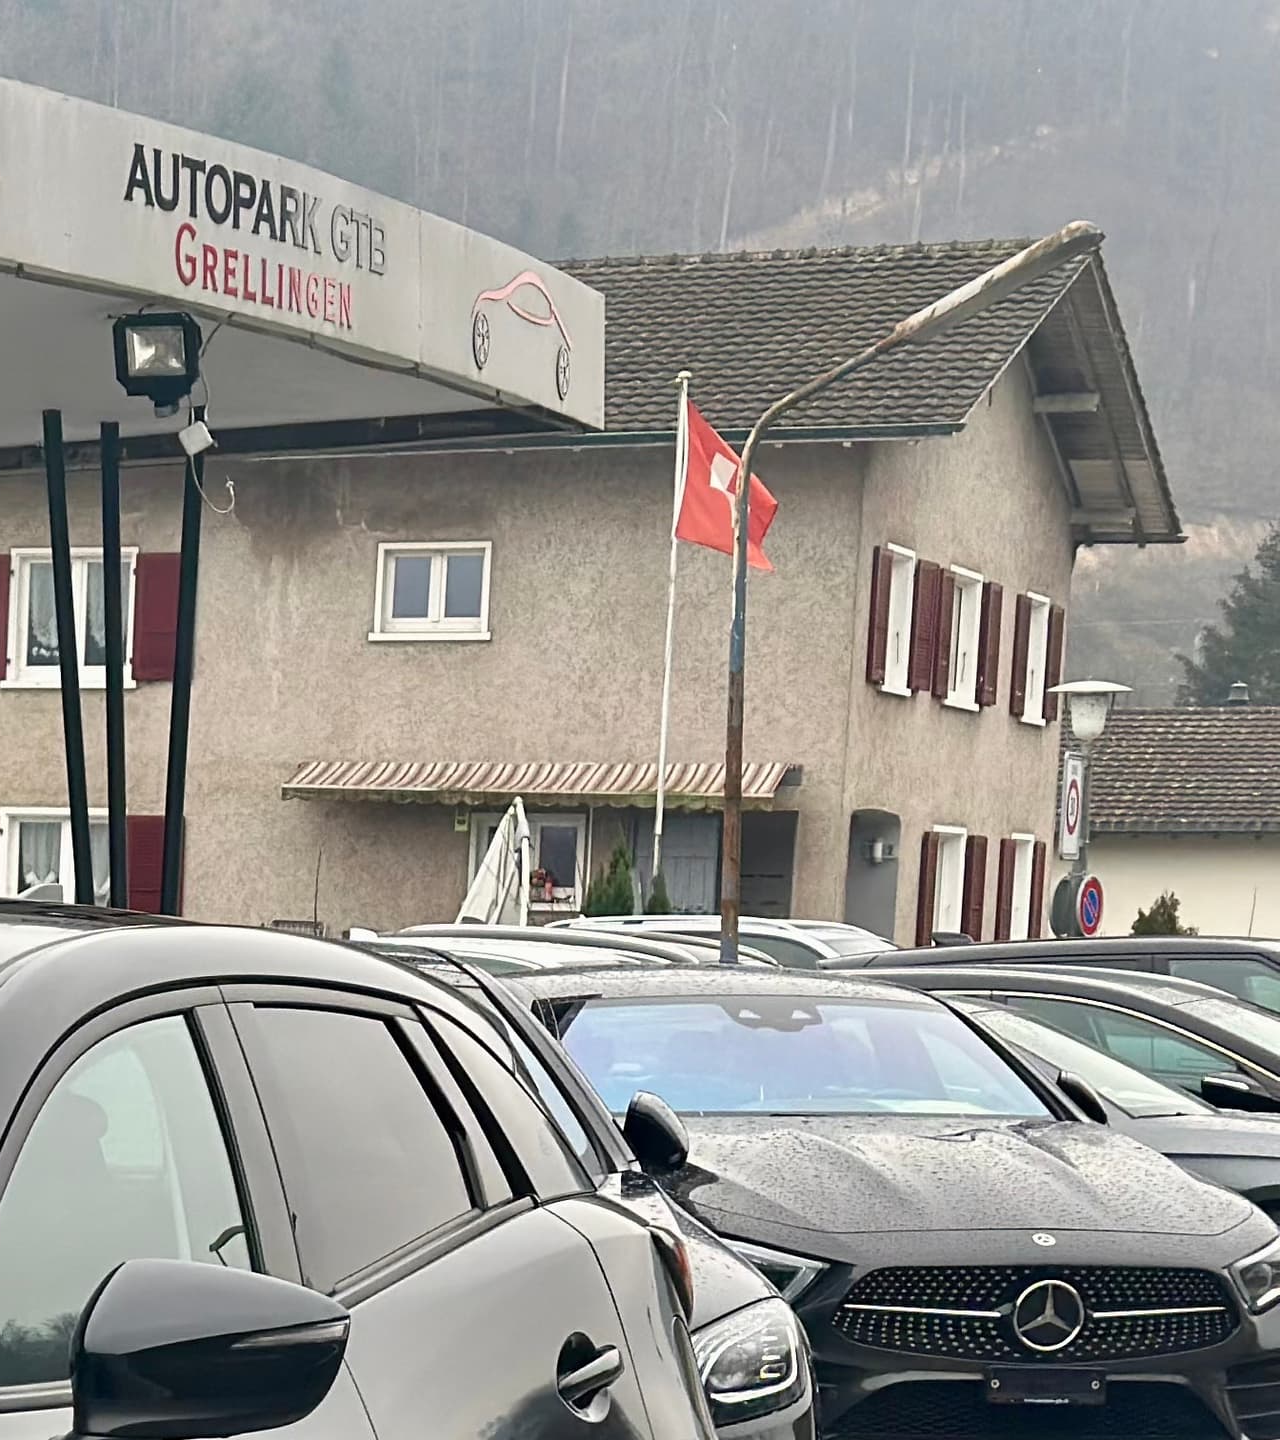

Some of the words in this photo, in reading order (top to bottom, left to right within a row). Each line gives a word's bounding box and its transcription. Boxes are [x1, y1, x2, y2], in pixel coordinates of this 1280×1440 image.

[124, 143, 321, 254] AUTOPARK
[330, 203, 386, 276] GTB
[175, 223, 352, 329] GRELLINGEN
